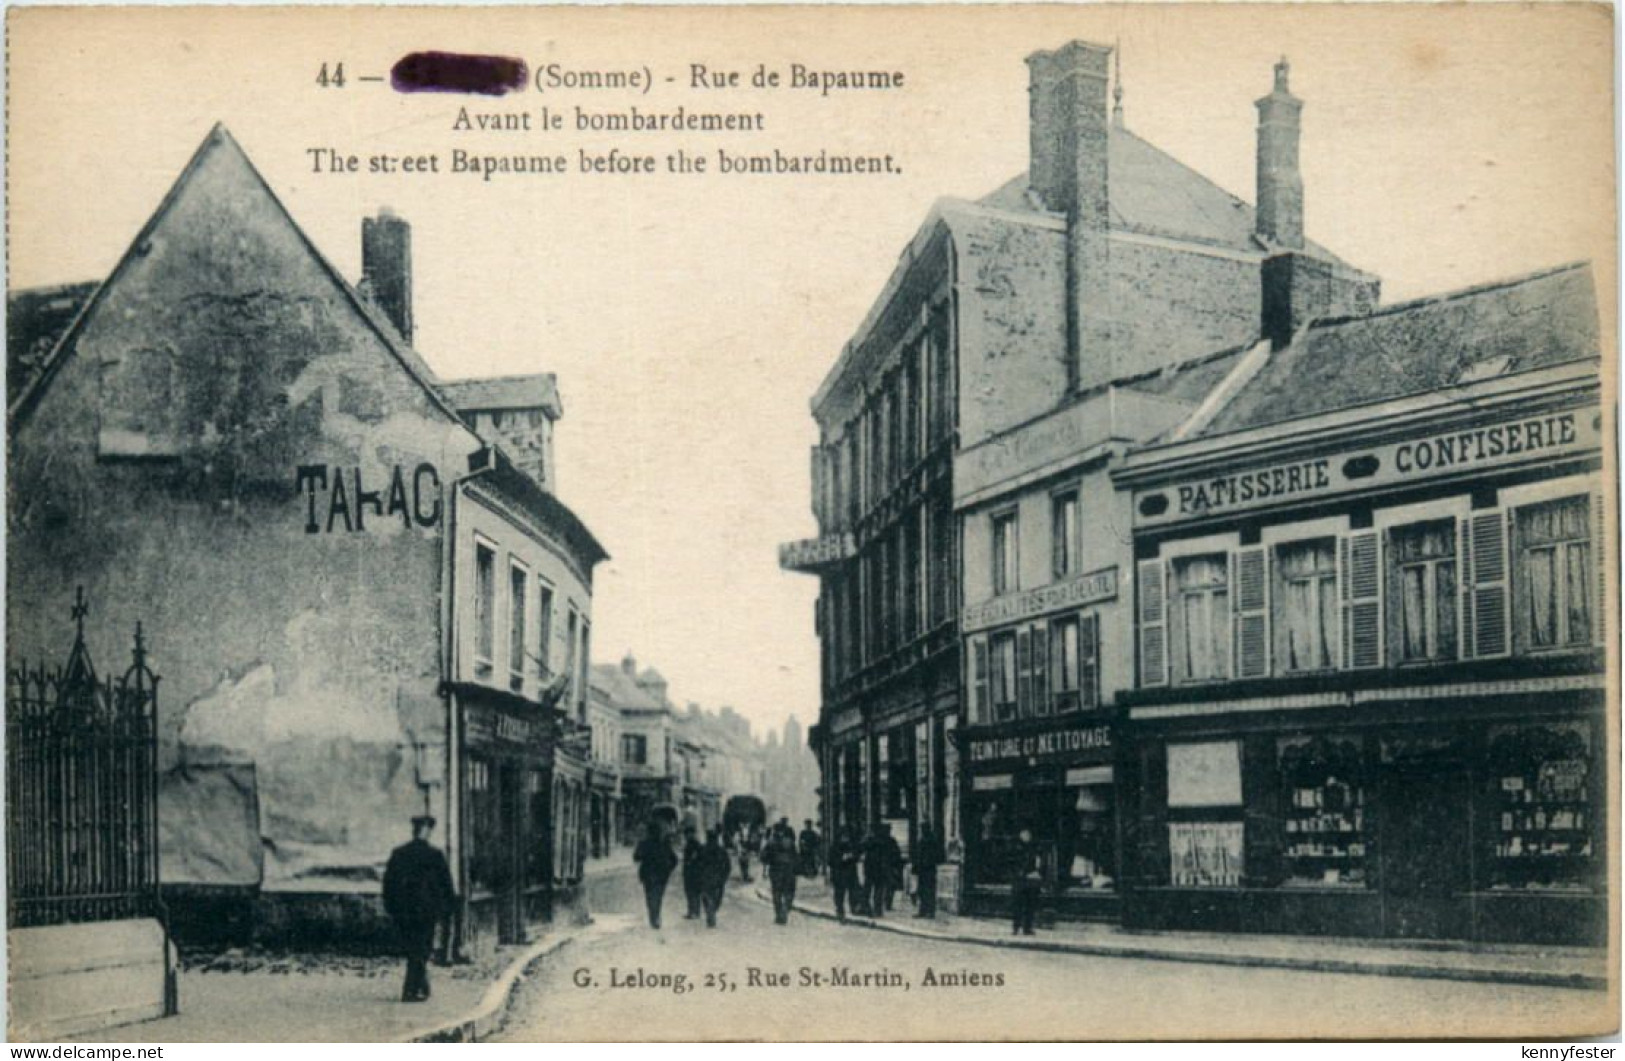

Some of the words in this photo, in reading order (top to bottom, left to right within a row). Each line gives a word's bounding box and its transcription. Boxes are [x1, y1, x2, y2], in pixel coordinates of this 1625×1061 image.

[1177, 460, 1330, 514] PATISSERIE
[1394, 413, 1577, 473] CONFISERIE
[1038, 725, 1112, 756] NETTOYAGE
